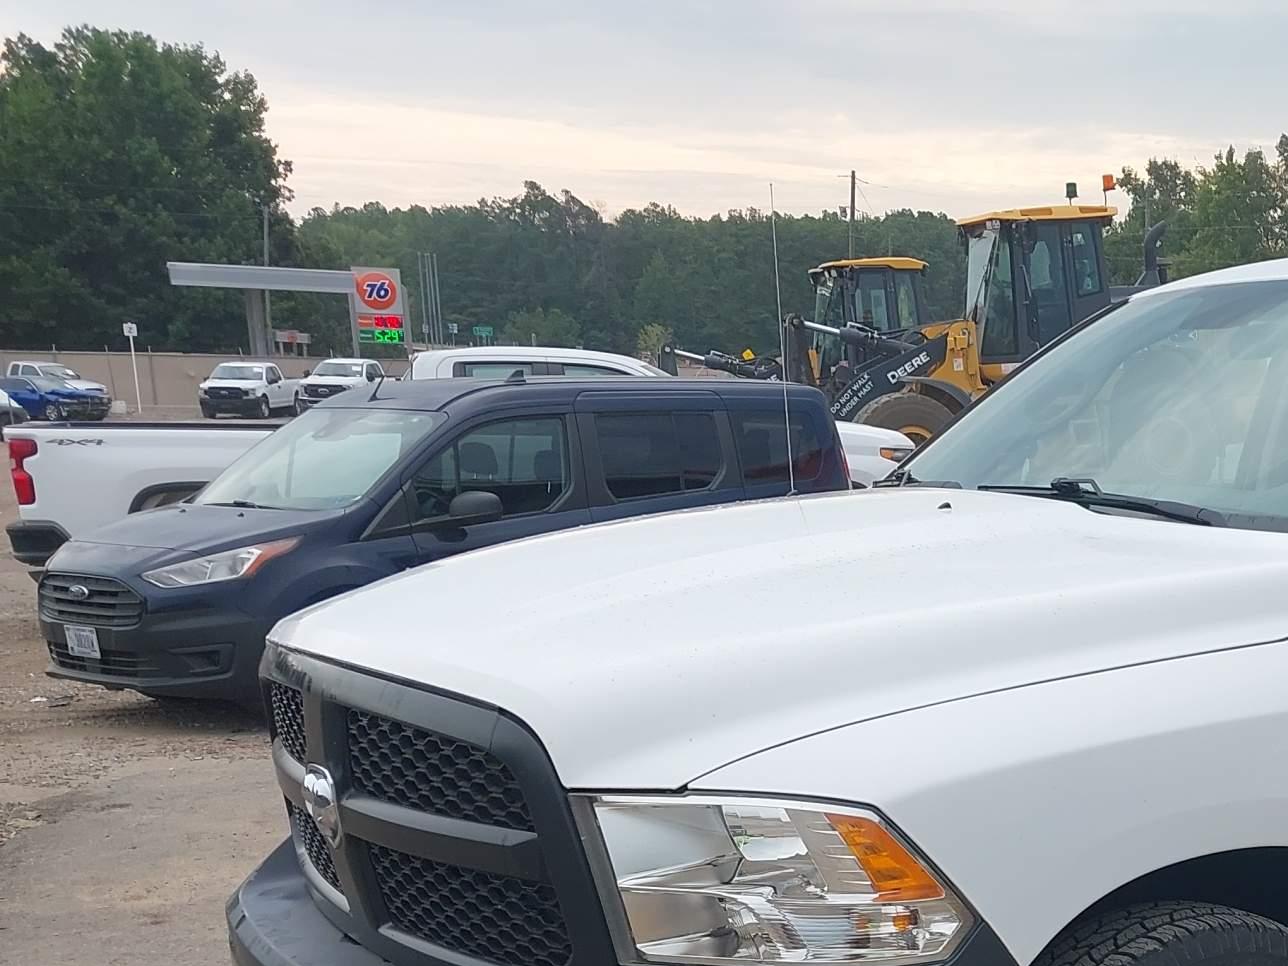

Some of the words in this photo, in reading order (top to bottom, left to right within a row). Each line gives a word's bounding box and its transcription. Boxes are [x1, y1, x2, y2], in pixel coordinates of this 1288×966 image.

[363, 280, 391, 301] 76
[886, 351, 931, 384] DEERE
[830, 402, 841, 414] DO
[840, 388, 853, 404] NOT
[852, 371, 871, 391] WALK
[839, 396, 859, 417] UNDER
